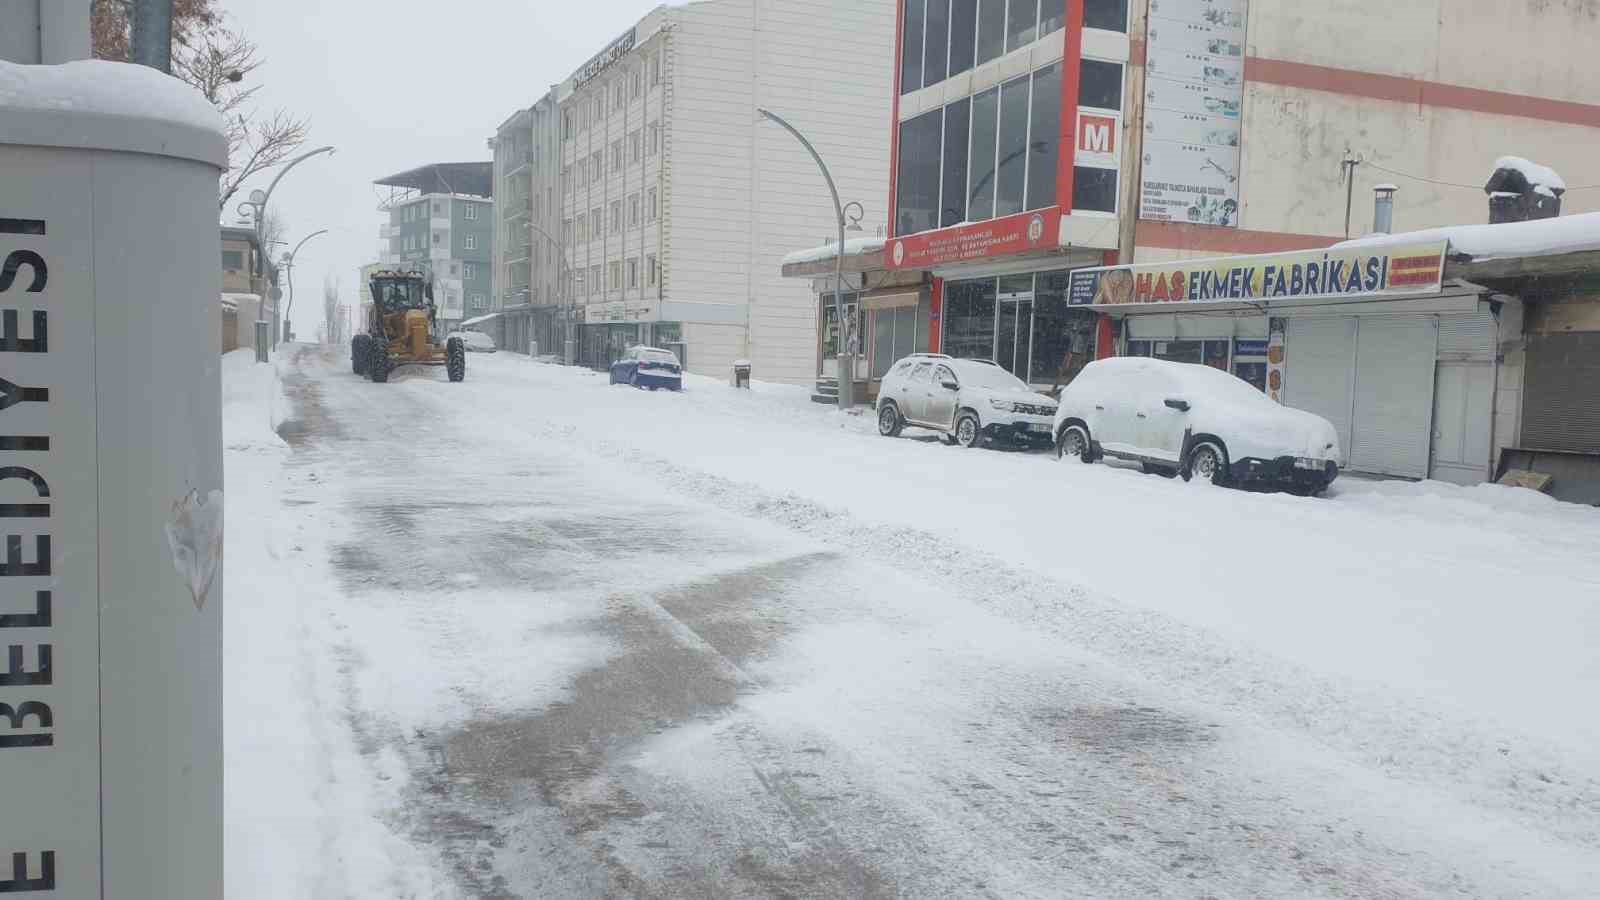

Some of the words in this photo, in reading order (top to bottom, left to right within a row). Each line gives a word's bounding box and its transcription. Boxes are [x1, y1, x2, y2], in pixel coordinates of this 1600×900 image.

[1084, 123, 1109, 152] M
[1136, 270, 1186, 303] HAS
[1188, 266, 1255, 301] EKMEK
[1262, 253, 1388, 297] FABRİKASI
